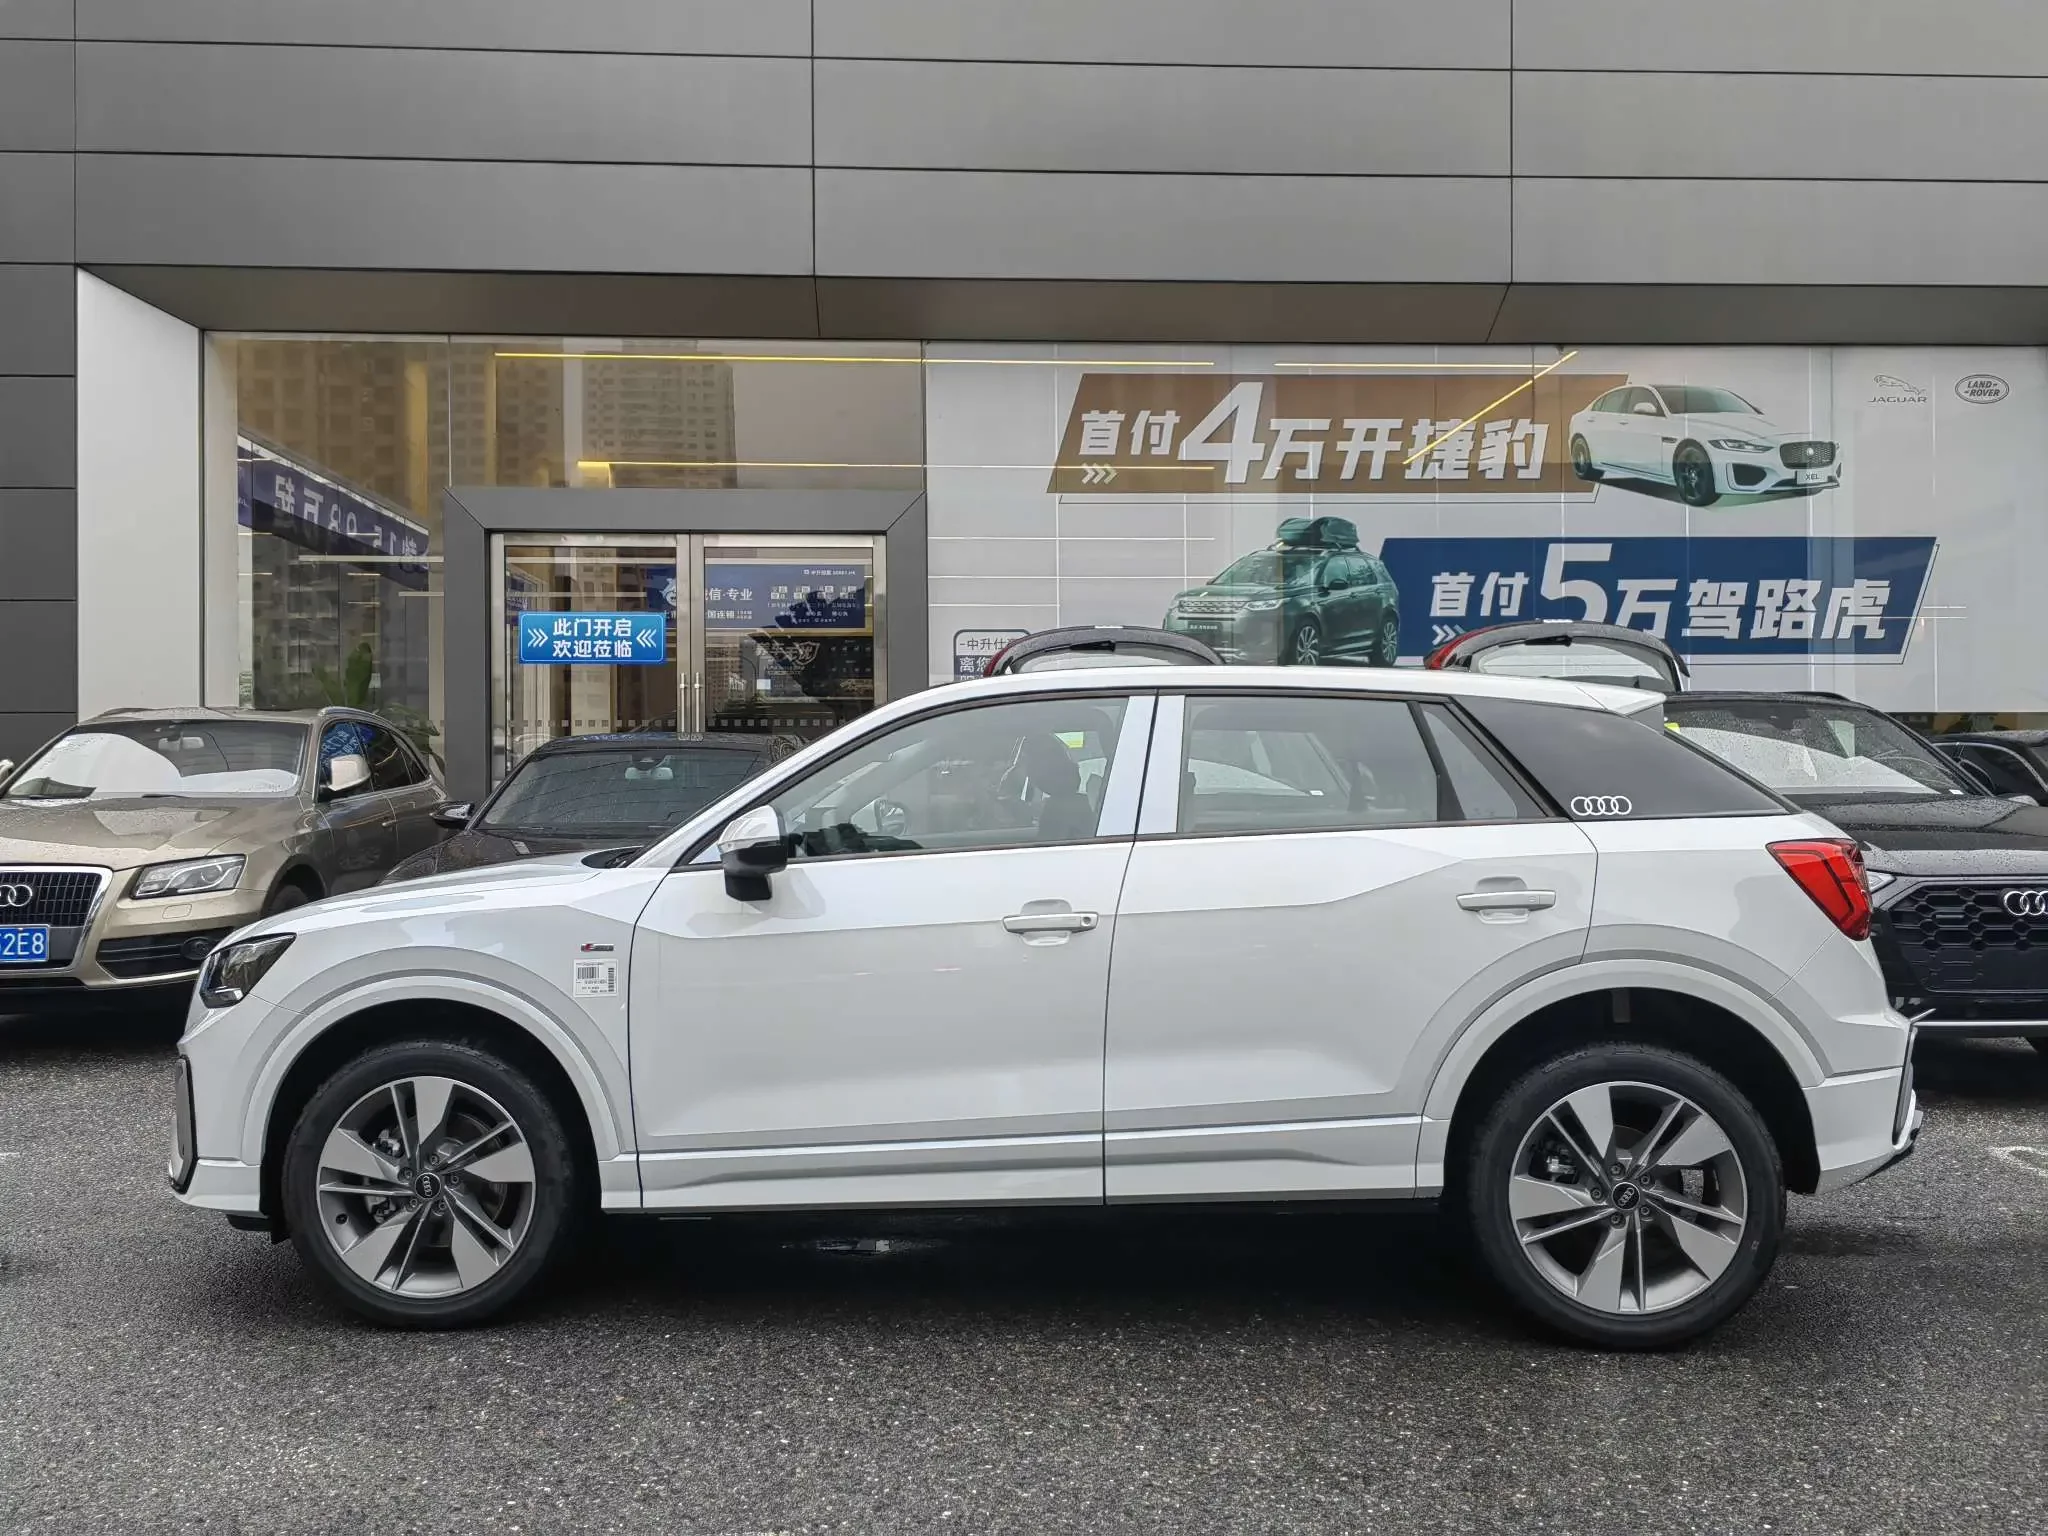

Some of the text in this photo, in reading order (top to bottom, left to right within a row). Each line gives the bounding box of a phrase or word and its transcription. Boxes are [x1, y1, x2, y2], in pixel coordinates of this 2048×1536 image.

[1868, 395, 1927, 403] JAGUAR
[1079, 381, 1549, 484] 首付4万开捷豹
[1429, 543, 1891, 640] 首付5万驾路虎
[552, 617, 632, 637] 此门开启
[552, 640, 633, 658] 欢迎莅临
[0, 932, 45, 956] 2E8
